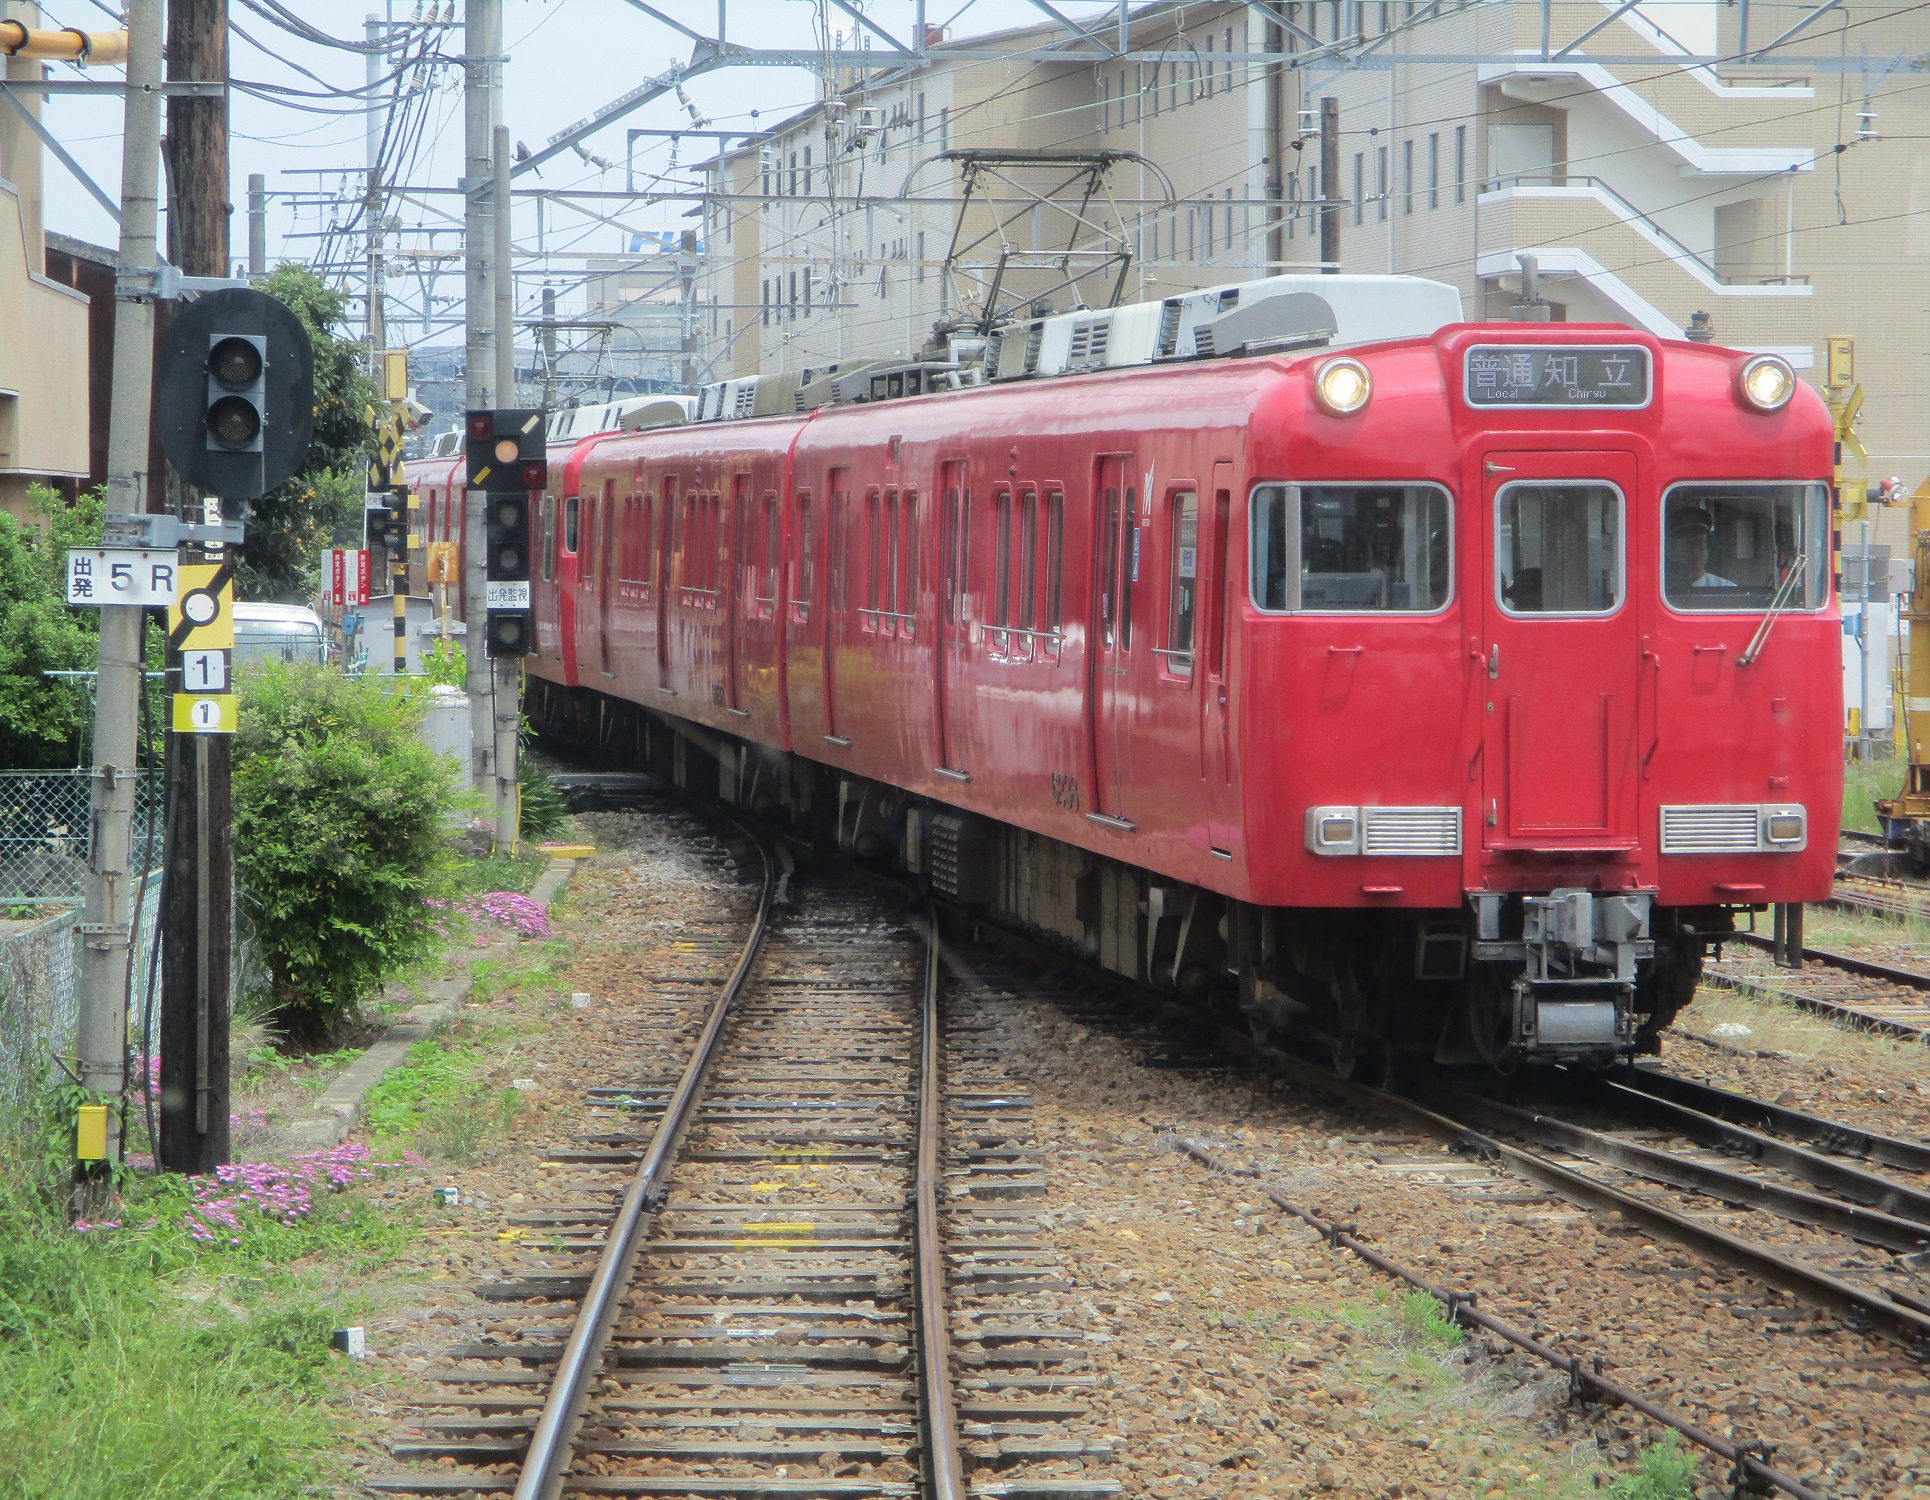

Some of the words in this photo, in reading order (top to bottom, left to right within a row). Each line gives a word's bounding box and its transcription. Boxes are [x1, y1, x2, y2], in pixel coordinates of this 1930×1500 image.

[1470, 353, 1534, 388] 普通
[1544, 353, 1632, 388] 知立
[1487, 388, 1518, 399] Local
[1568, 388, 1606, 399] Chiryu
[72, 556, 93, 598] 出発
[111, 563, 134, 591] 5
[151, 564, 173, 592] R
[488, 587, 527, 602] 出発監視
[195, 655, 209, 685] 1
[200, 703, 209, 724] 1
